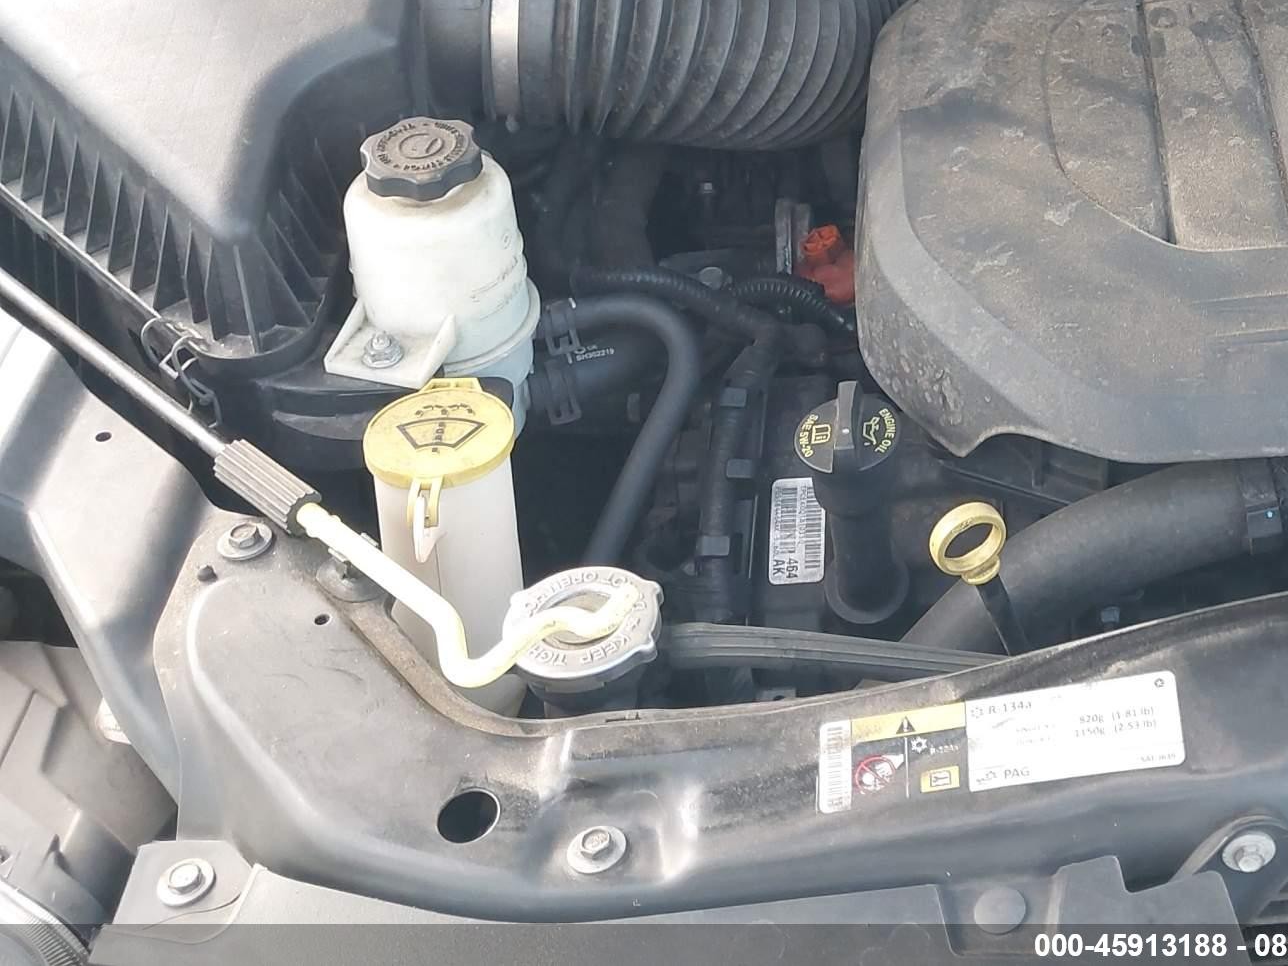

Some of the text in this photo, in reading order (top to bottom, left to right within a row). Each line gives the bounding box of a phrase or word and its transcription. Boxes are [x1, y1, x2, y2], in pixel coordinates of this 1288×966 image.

[799, 414, 819, 458] SAE 5W-20
[874, 408, 896, 454] ENGINE OIL
[772, 559, 786, 576] AK
[785, 557, 799, 579] 464
[1003, 767, 1031, 780] PAG
